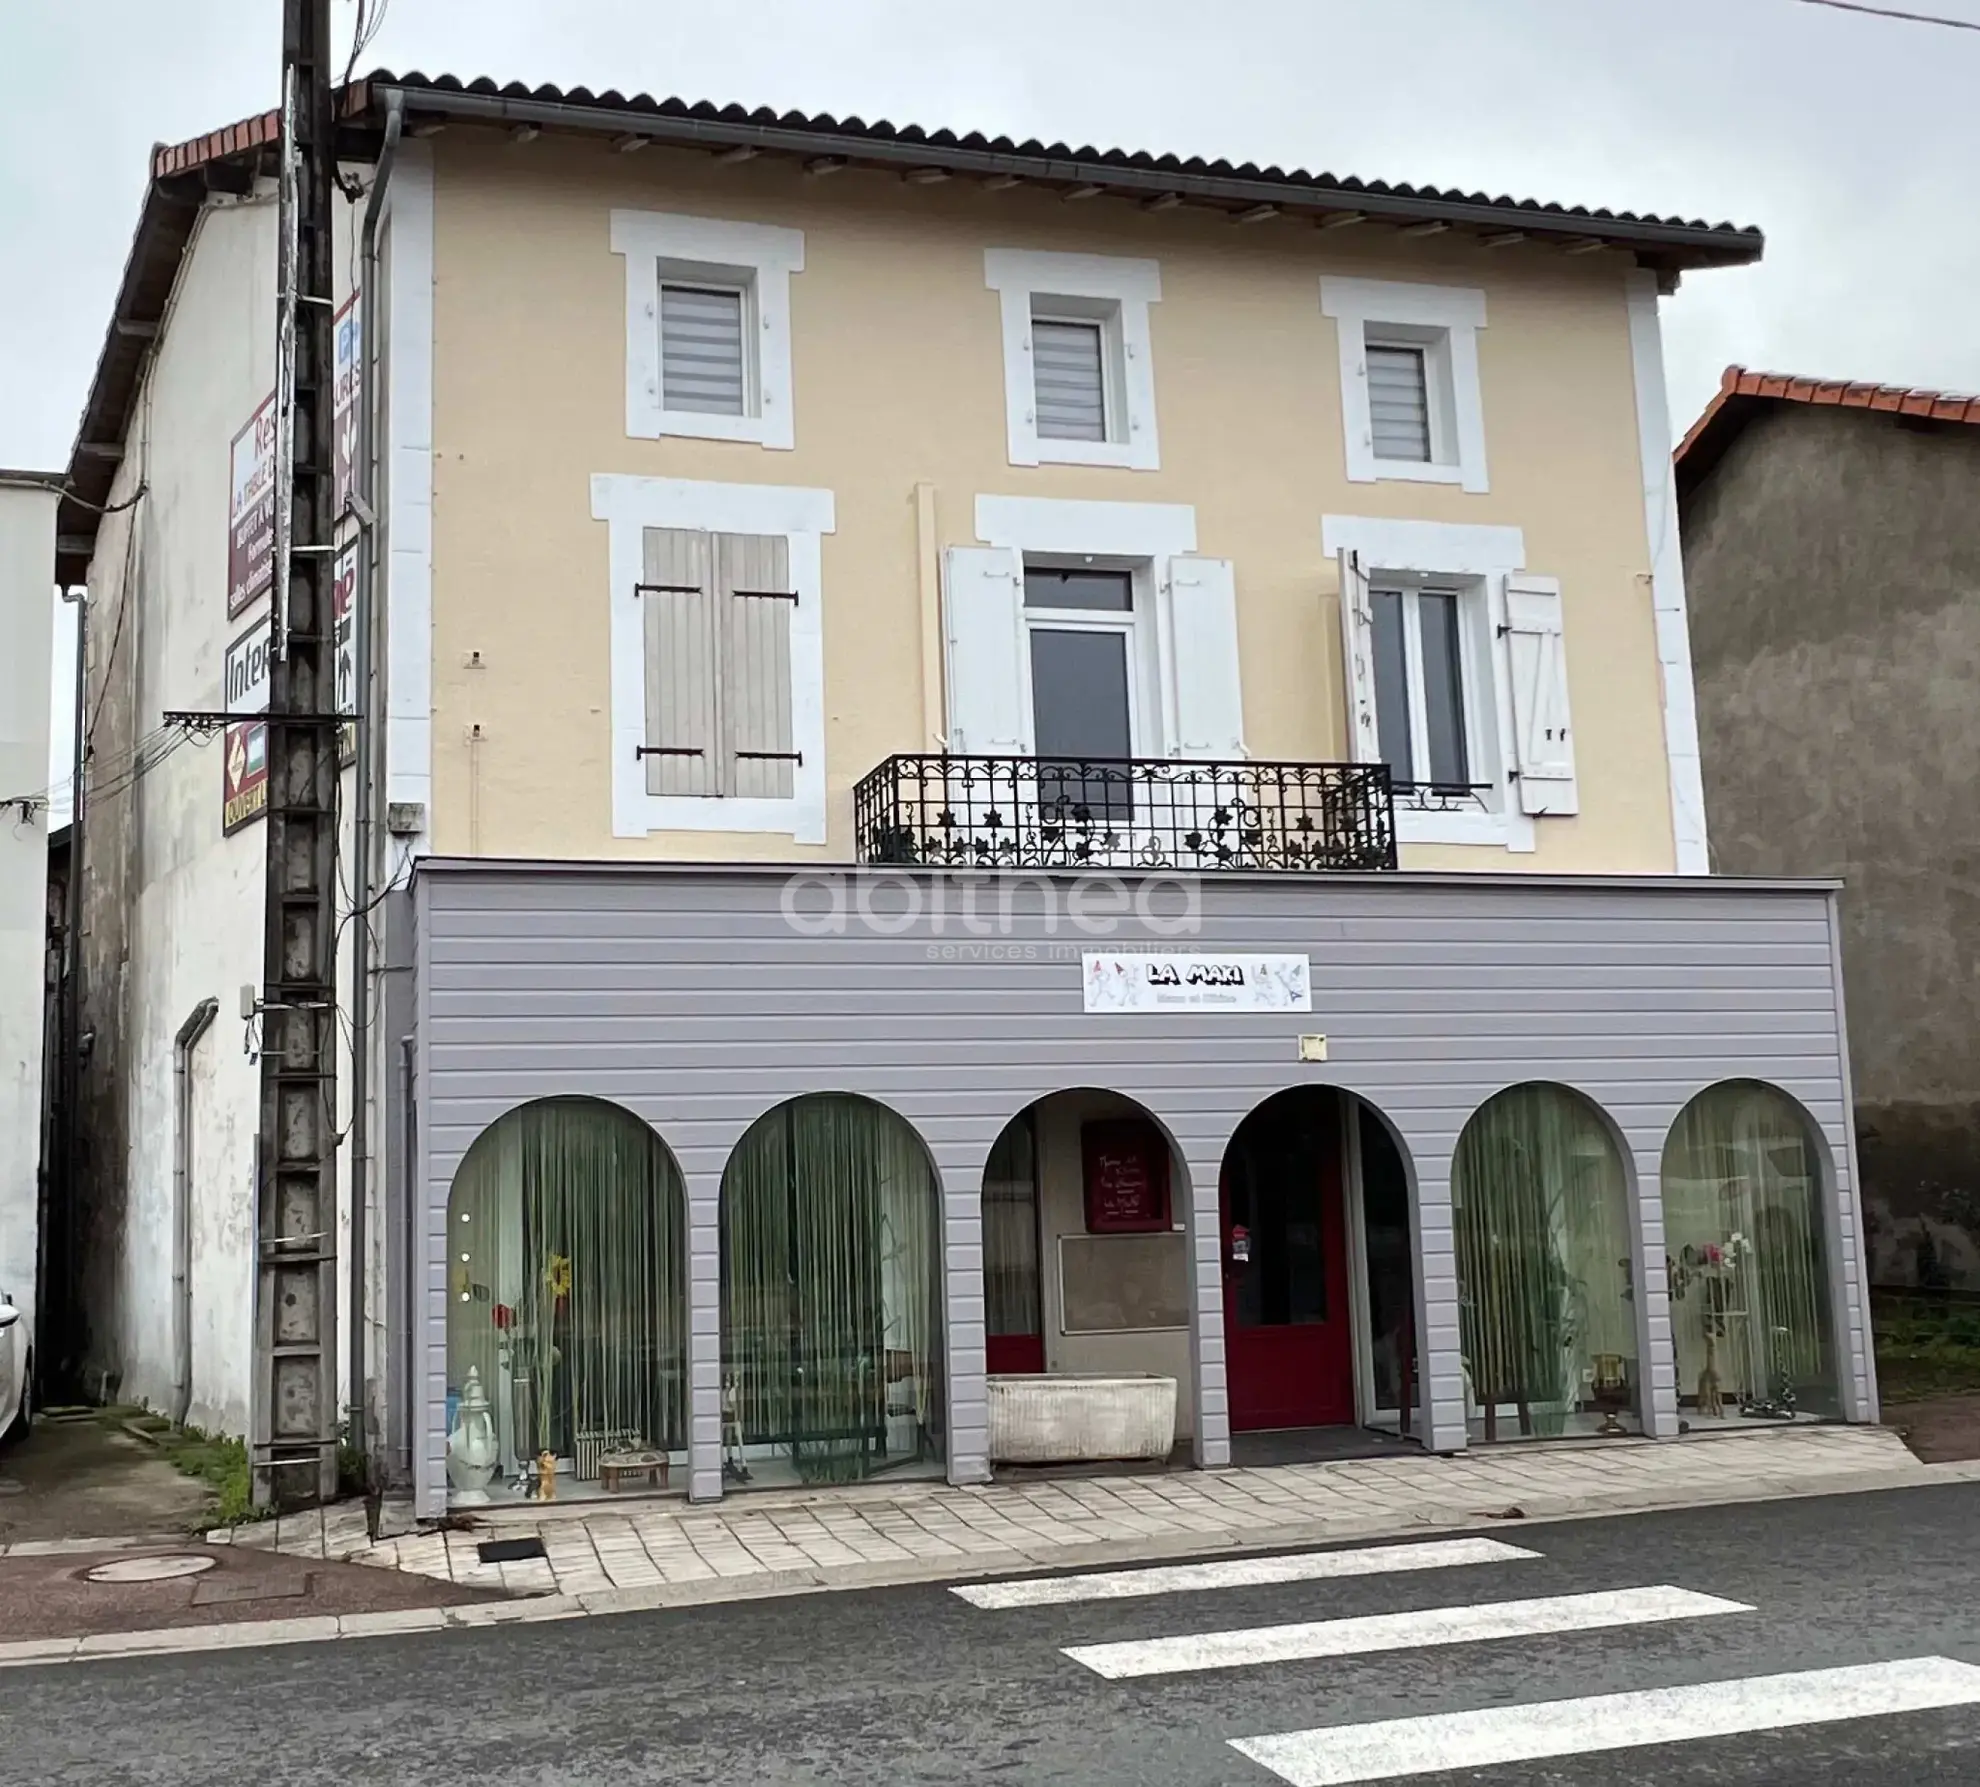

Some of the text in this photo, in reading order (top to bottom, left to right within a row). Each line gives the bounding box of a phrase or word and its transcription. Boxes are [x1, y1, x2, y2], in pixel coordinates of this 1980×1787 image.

[254, 411, 277, 459] Res
[1146, 963, 1245, 986] LA MAKI
